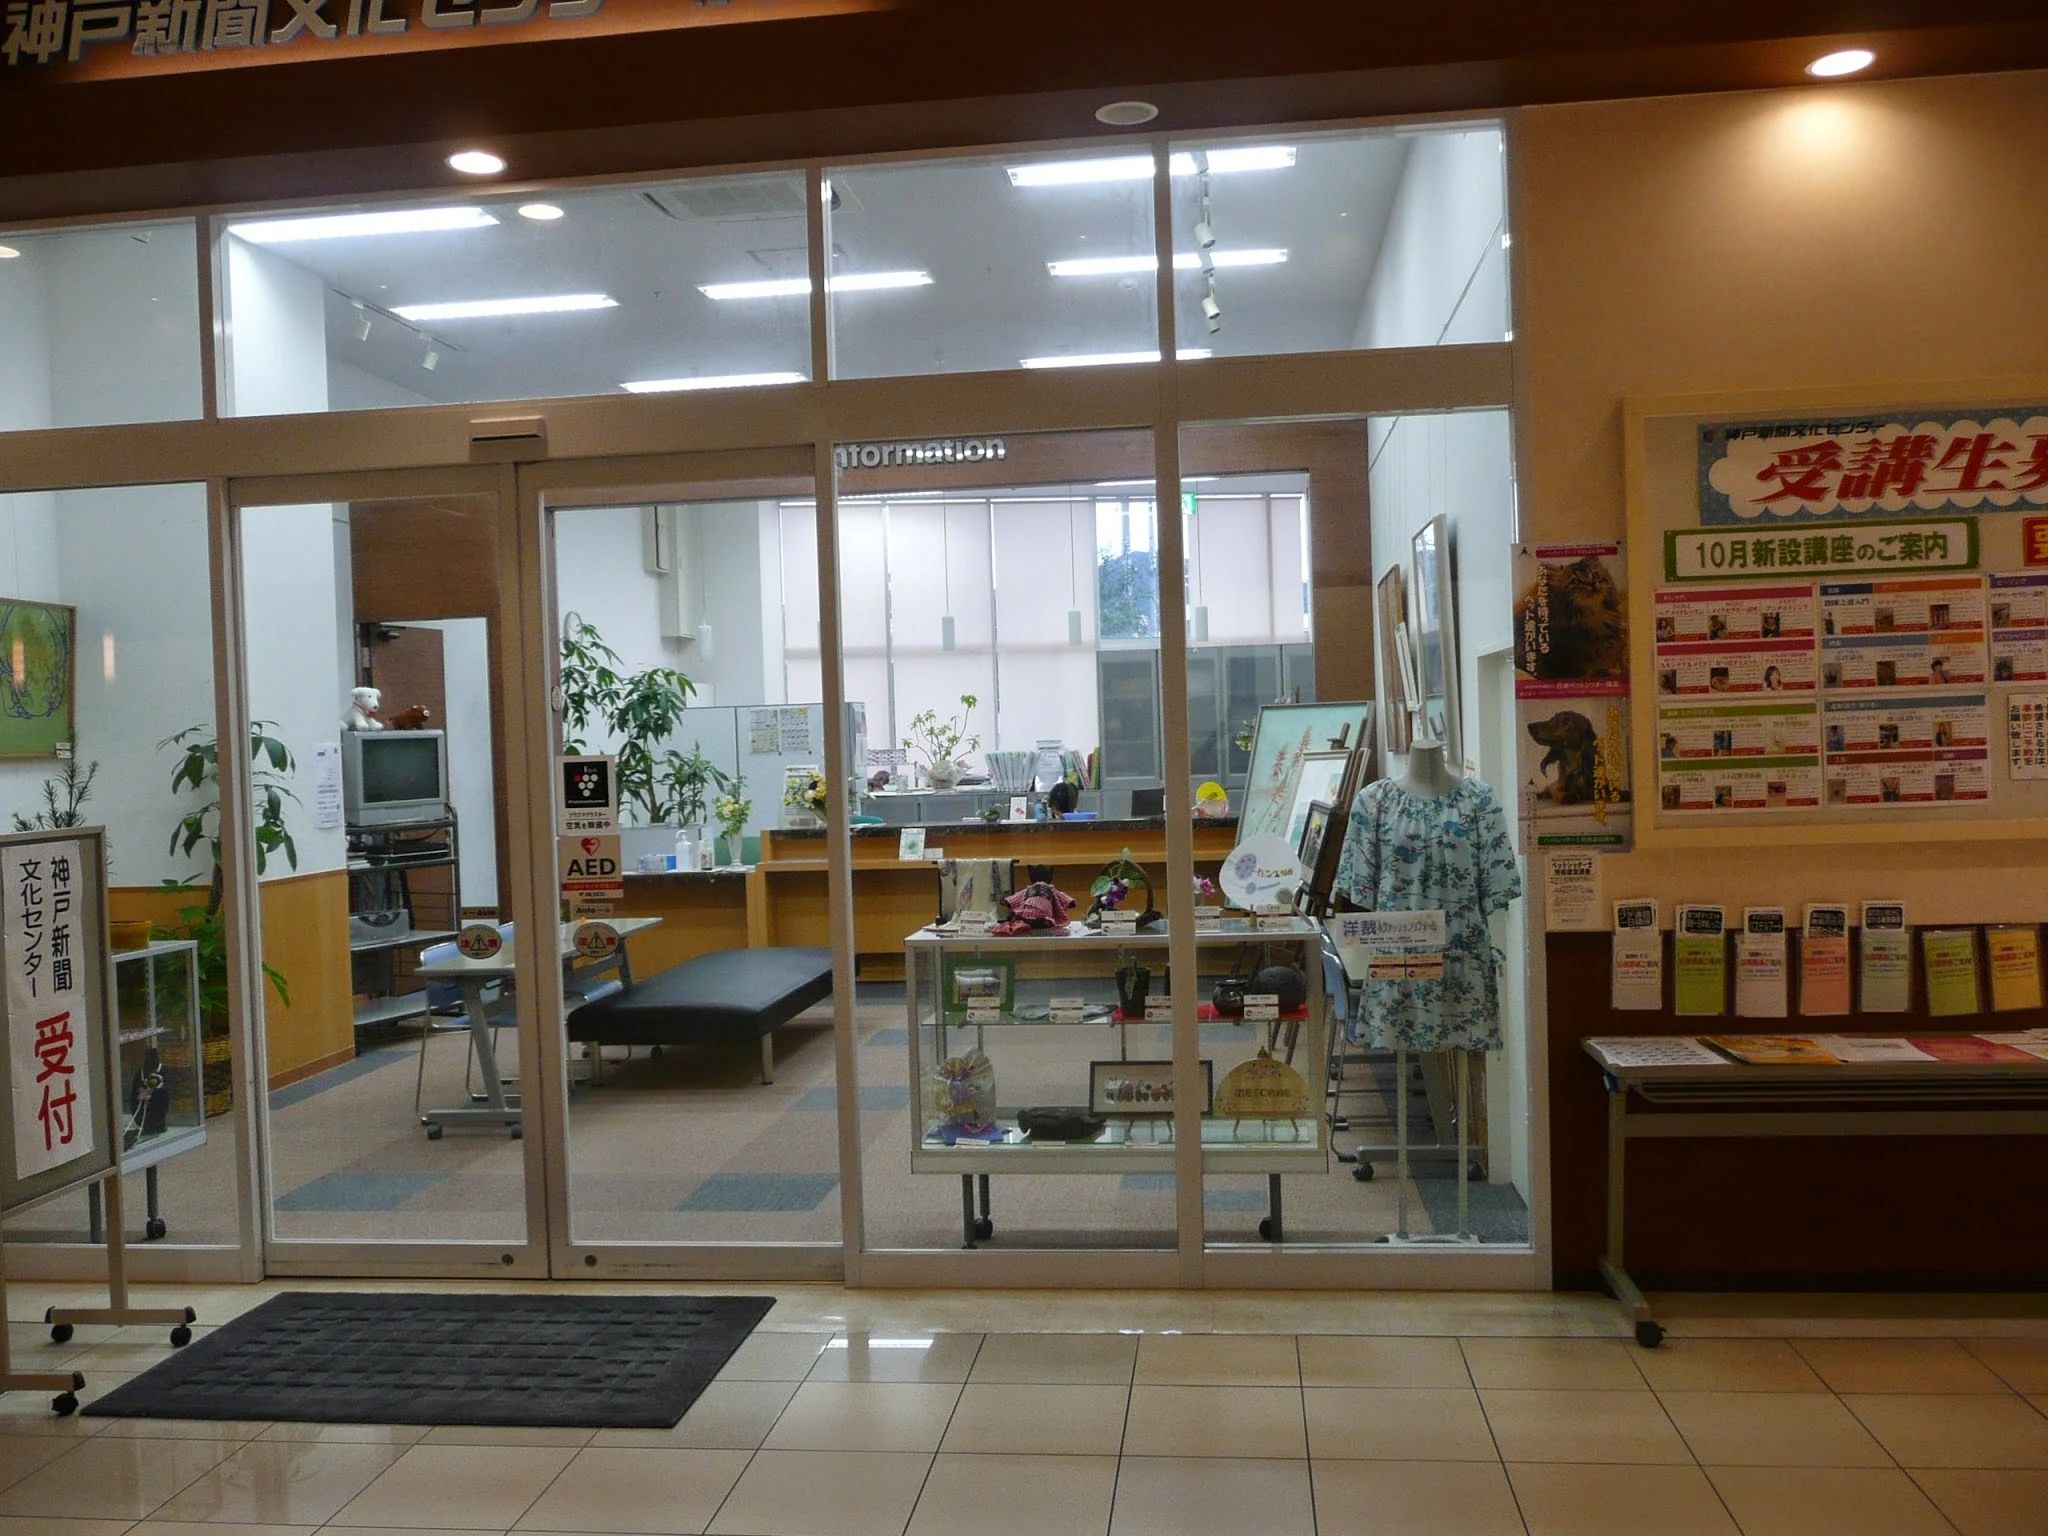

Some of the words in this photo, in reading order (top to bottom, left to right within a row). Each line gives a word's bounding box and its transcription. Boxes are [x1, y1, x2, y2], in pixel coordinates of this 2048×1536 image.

[2, 0, 605, 65] 神戸新聞文化
[1725, 420, 1887, 441] 神戸新聞文化センター
[835, 437, 1007, 469] nformation
[1696, 531, 1949, 570] 10月新設講座のご案内
[2010, 705, 2022, 769] お願い致します。
[566, 821, 611, 830] 空気を除菌中
[567, 858, 616, 876] AED
[19, 858, 43, 998] 文化センター
[51, 855, 72, 992] 神戸新聞
[576, 906, 596, 914] Auto
[34, 1010, 77, 1151] 受付
